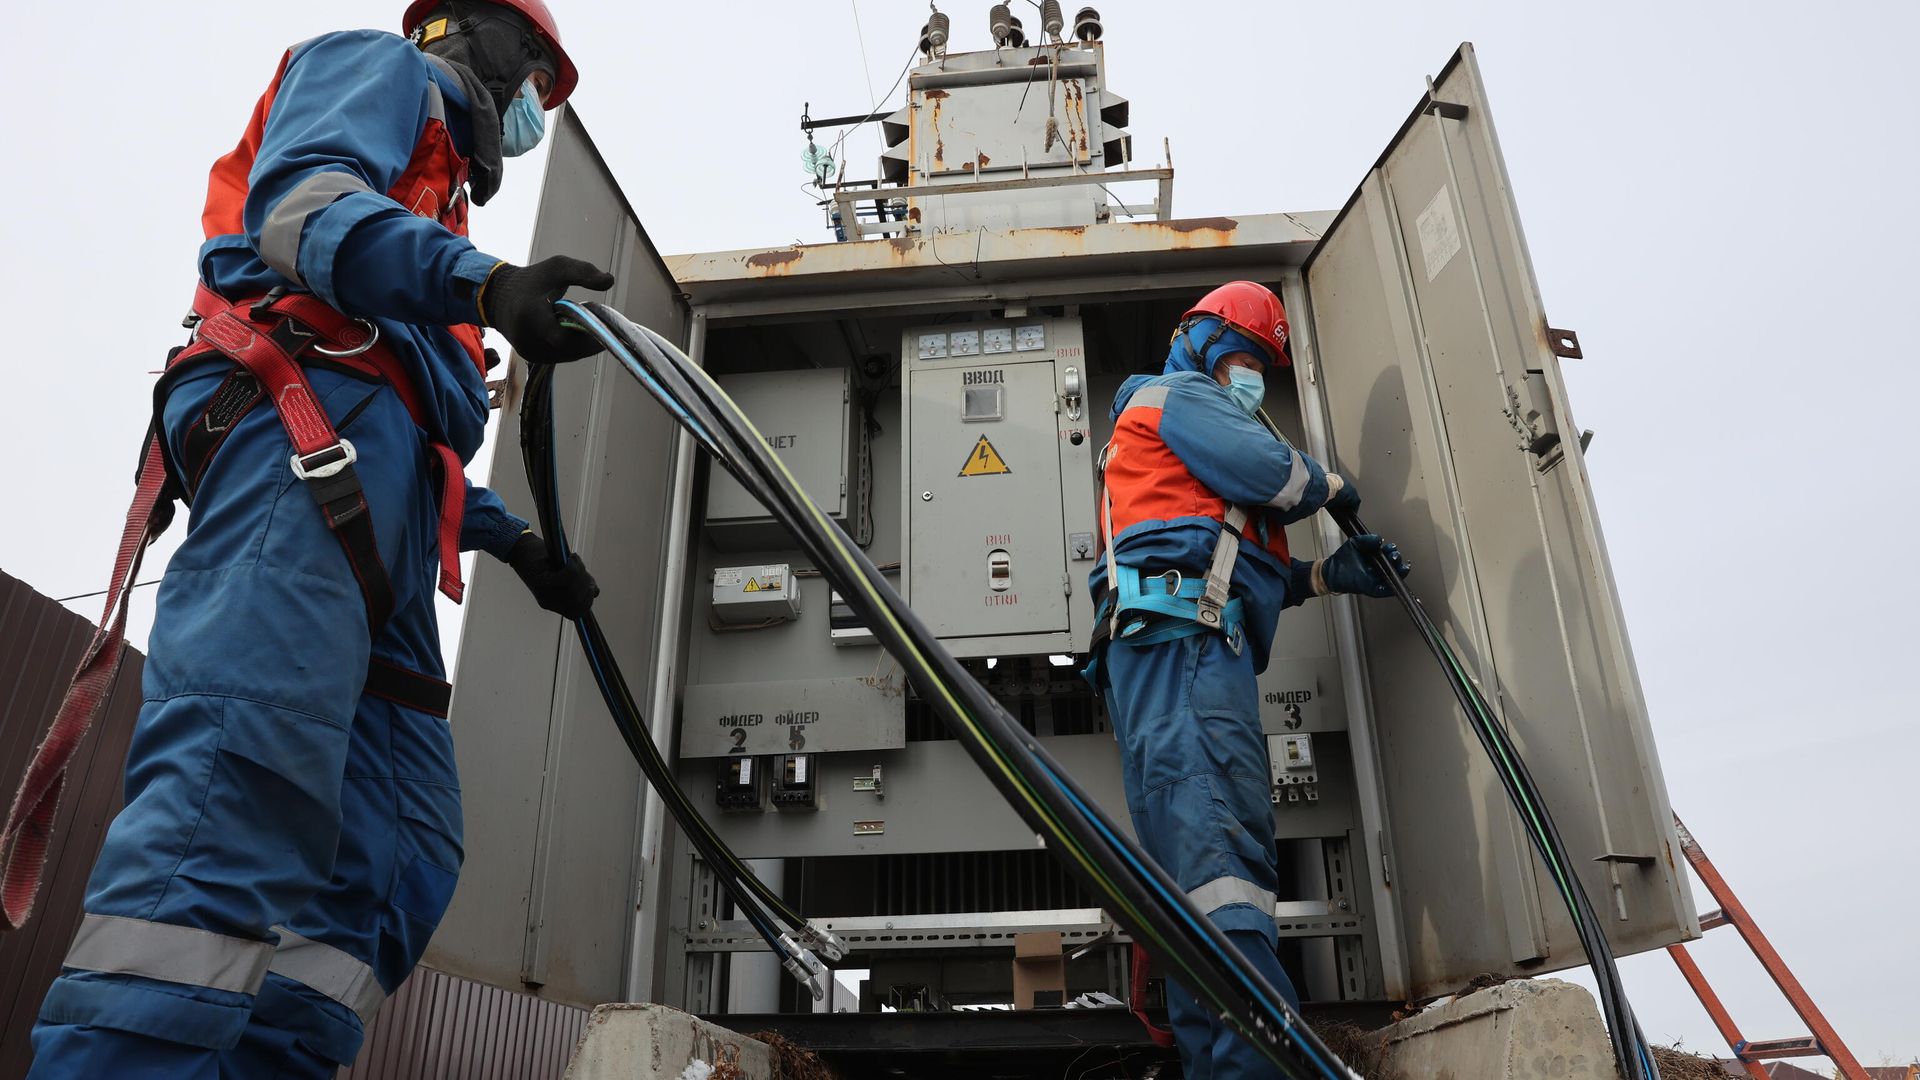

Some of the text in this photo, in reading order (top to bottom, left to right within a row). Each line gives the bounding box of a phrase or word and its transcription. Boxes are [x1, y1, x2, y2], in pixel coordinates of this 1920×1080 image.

[962, 370, 1005, 385] ВВОД
[765, 435, 797, 449] ЧЕТ
[1265, 691, 1312, 704] ФИДЕР
[719, 714, 763, 727] ФИДЕР
[775, 711, 819, 725] ФИДЕР
[1284, 704, 1302, 730] 3
[729, 728, 747, 753] 2
